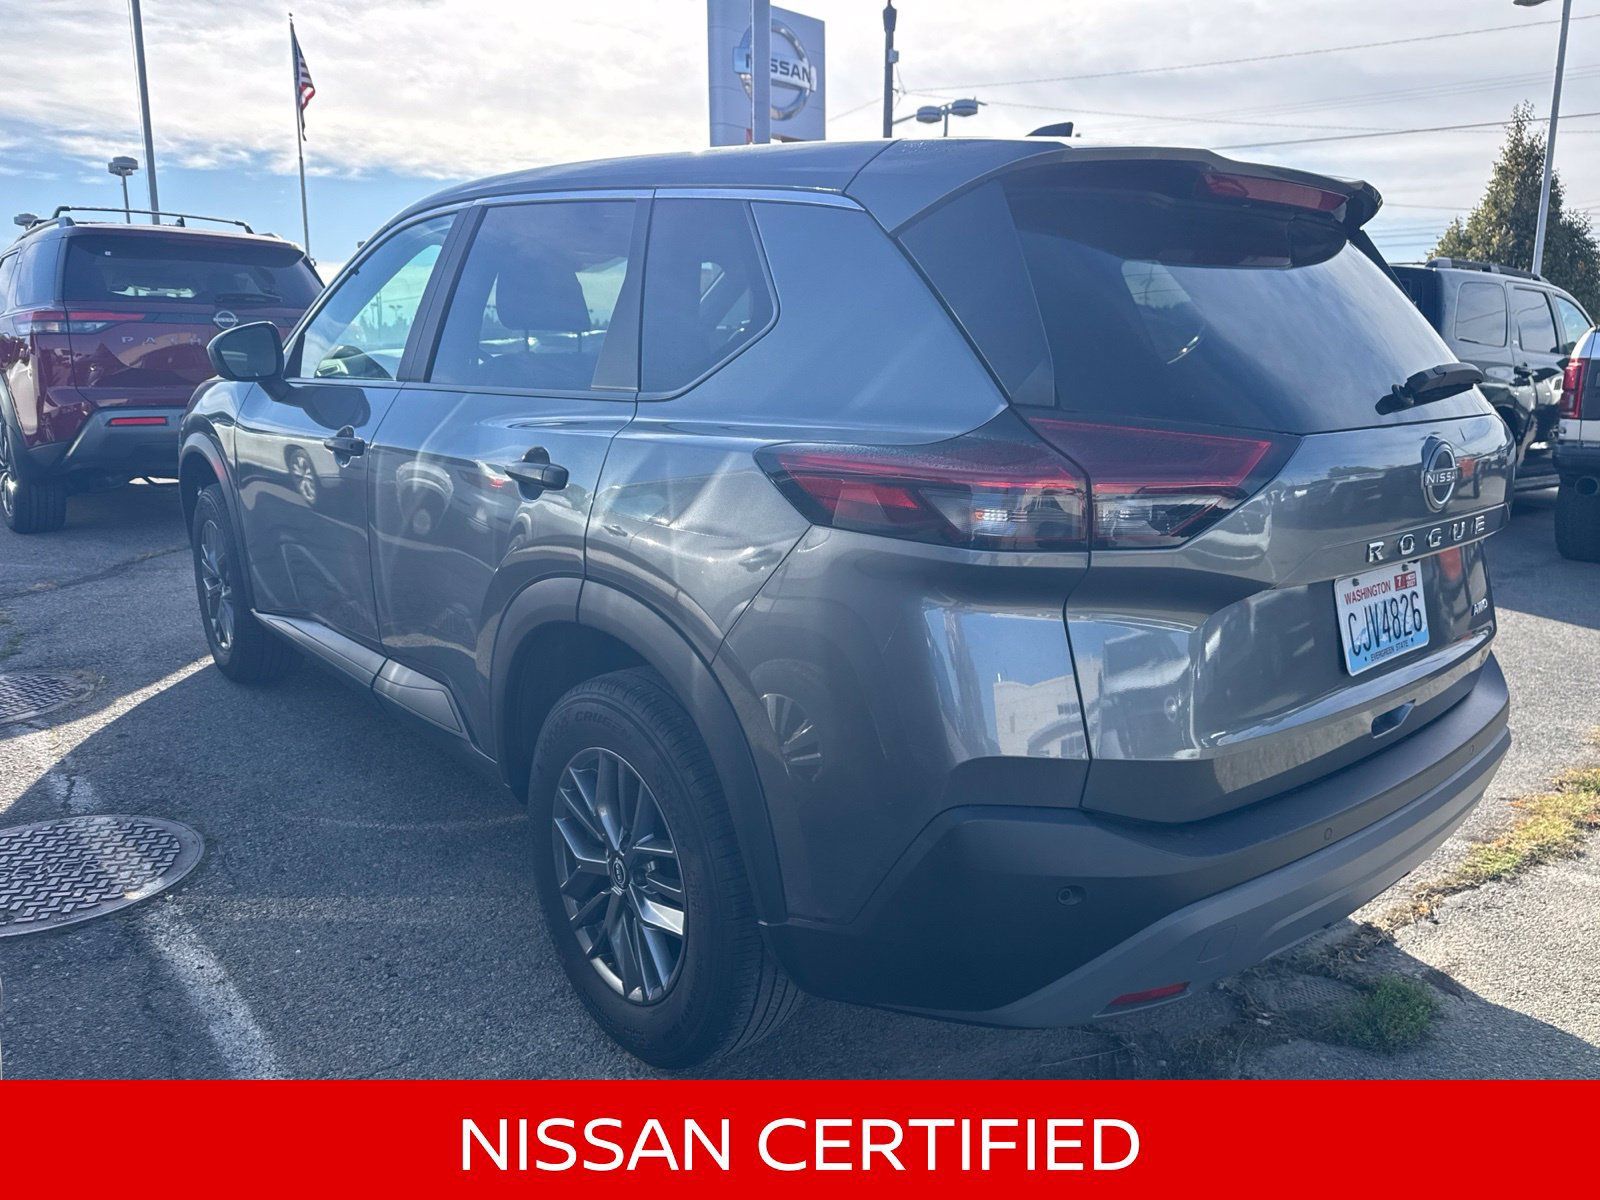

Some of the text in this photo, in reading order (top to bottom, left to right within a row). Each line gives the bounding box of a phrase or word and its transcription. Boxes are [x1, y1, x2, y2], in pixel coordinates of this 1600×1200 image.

[745, 53, 812, 83] SSAN
[1366, 515, 1485, 562] ROGUE
[1344, 580, 1391, 605] WASHINGTON
[1348, 590, 1423, 657] CJV4826
